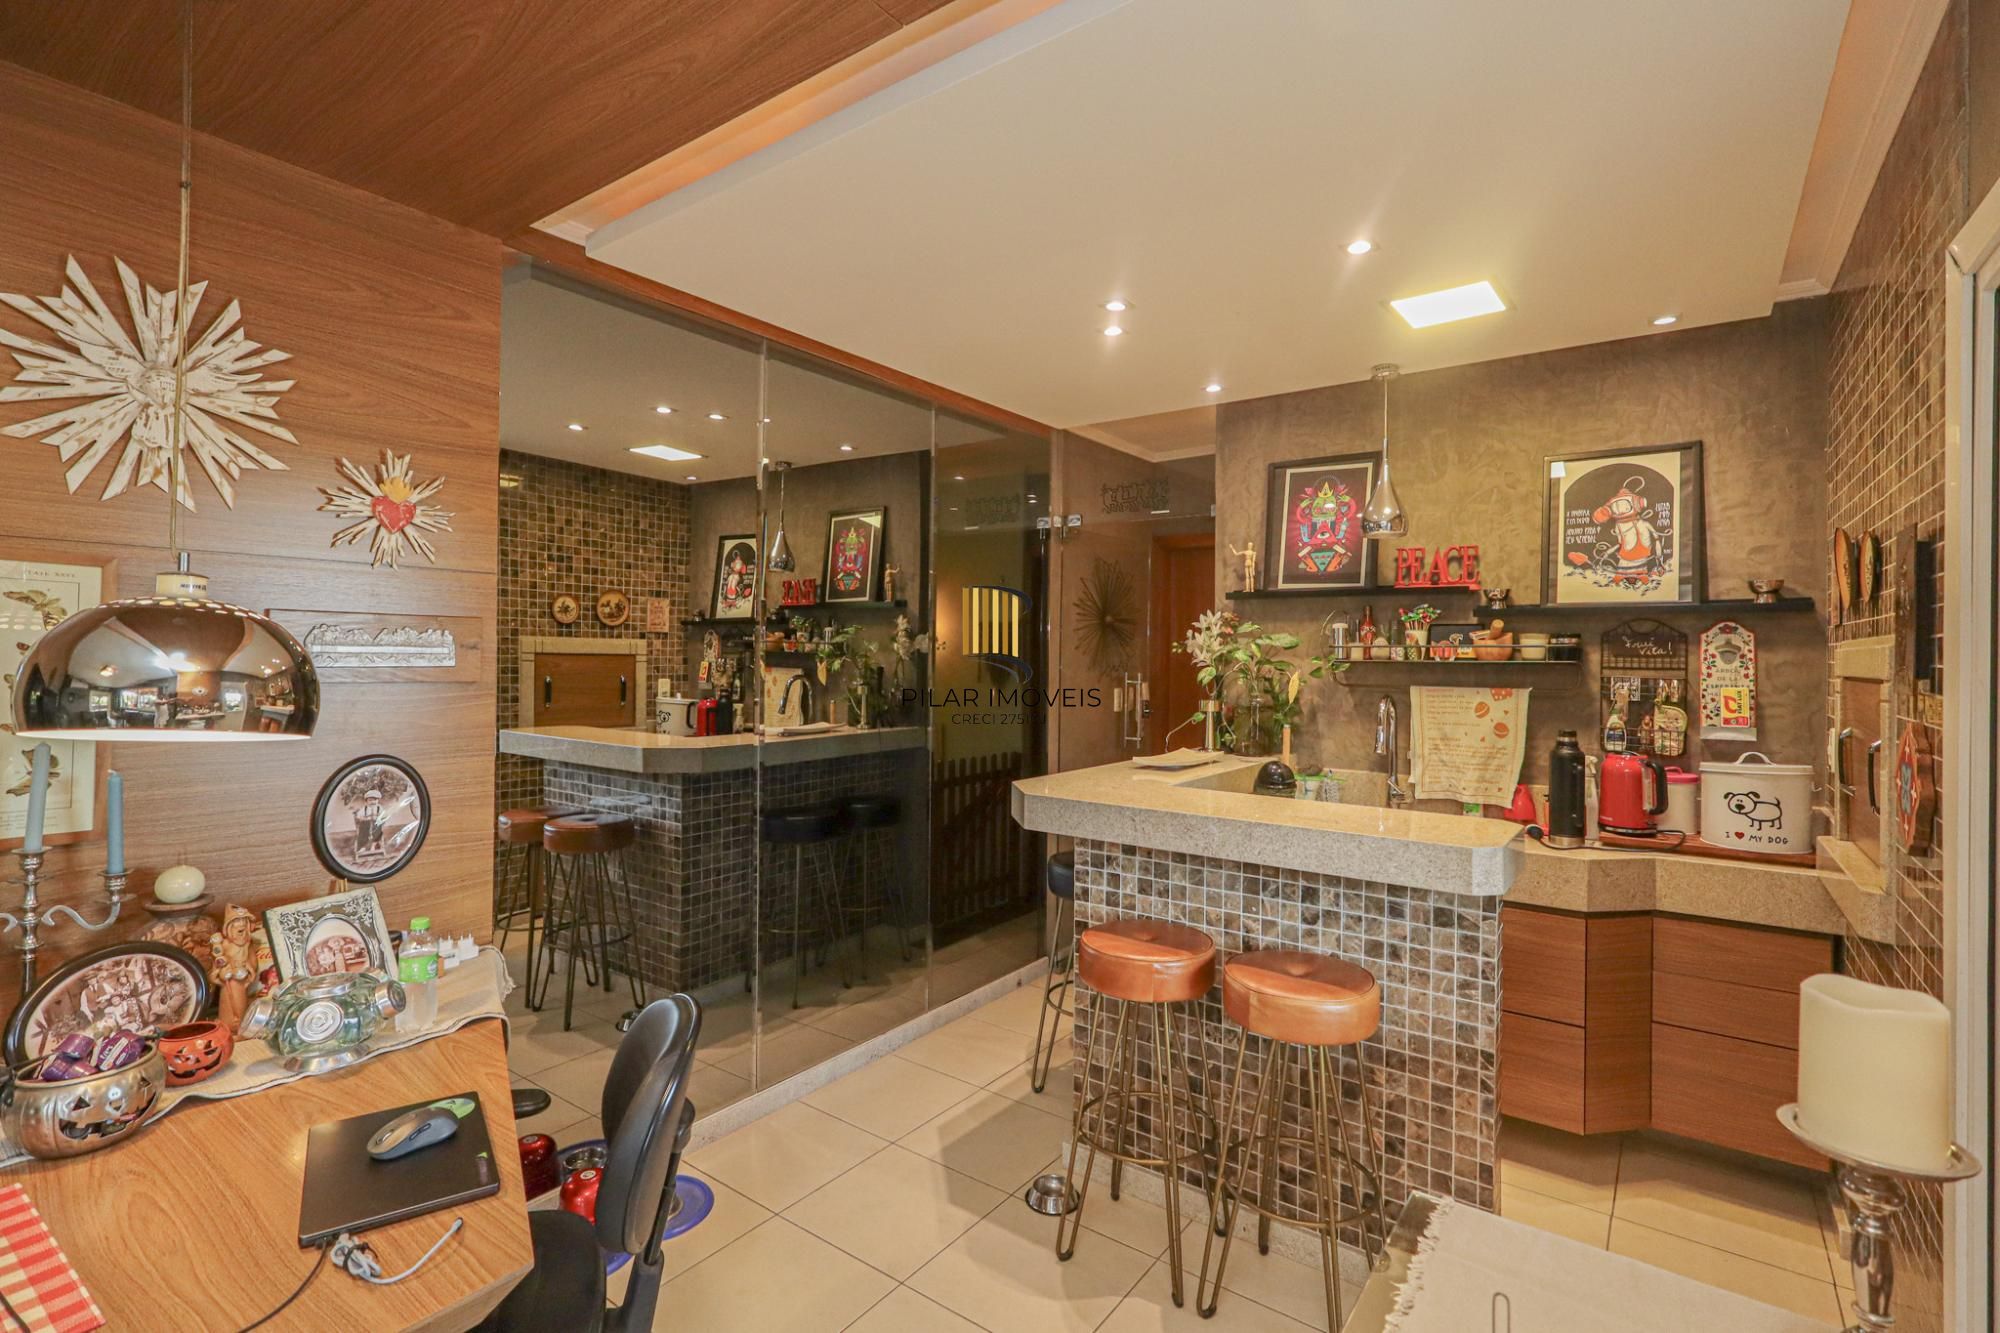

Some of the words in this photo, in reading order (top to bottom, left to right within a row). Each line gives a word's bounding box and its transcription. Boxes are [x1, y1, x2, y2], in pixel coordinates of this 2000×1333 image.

[1395, 544, 1480, 586] PEACE
[1749, 834, 1762, 843] MY
[1768, 836, 1789, 845] DOG
